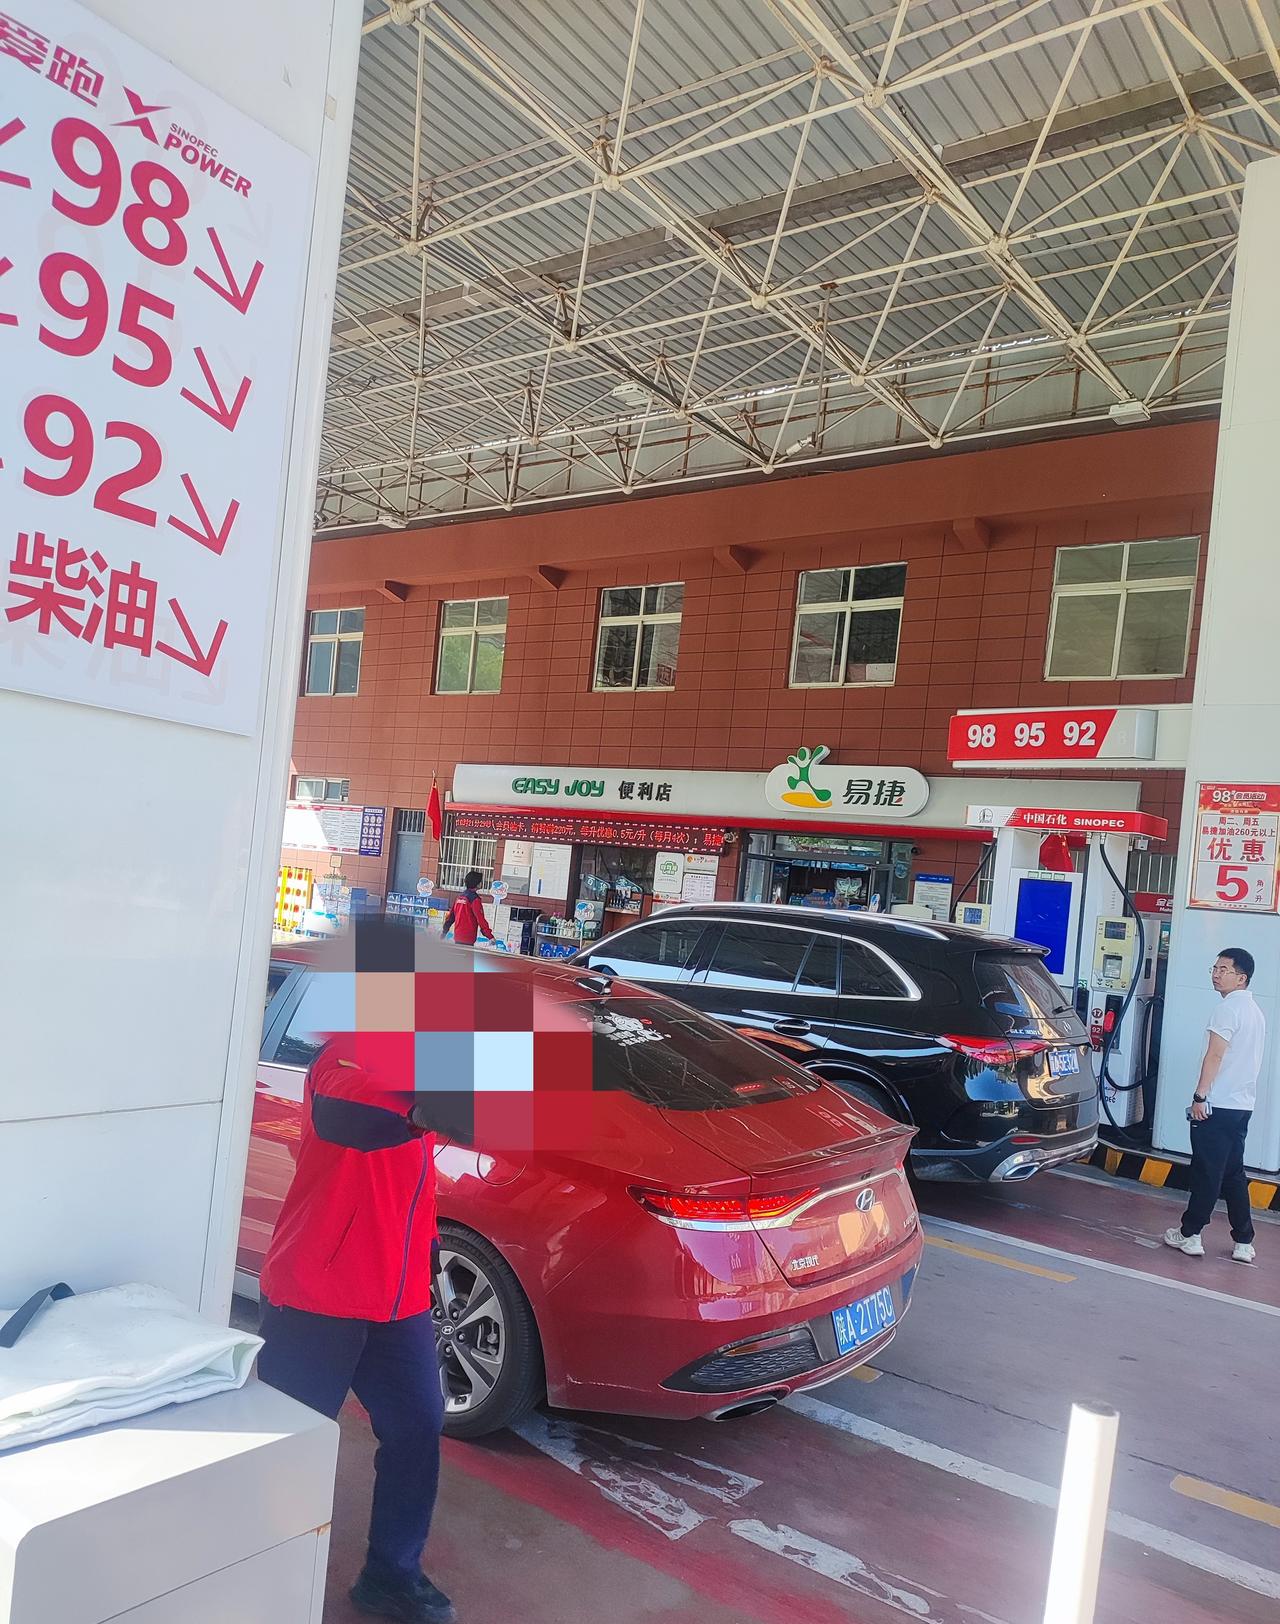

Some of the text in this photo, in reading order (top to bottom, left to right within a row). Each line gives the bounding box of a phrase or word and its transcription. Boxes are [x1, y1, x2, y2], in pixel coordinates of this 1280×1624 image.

[169, 123, 219, 158] SINOPEC
[163, 133, 252, 199] POWER
[51, 117, 190, 266] 98
[39, 252, 175, 388] 95
[23, 394, 163, 528] 92
[4, 531, 158, 658] 柴油
[968, 721, 1097, 748] 98 95 92
[512, 778, 672, 801] EASY JOY 便利店
[842, 779, 906, 806] 易捷
[1023, 813, 1125, 828] 中国石化 SINOPEC
[1207, 838, 1266, 862] 优惠
[1216, 865, 1249, 902] 5
[1092, 1026, 1102, 1034] 92
[791, 1255, 820, 1271] 北京现代
